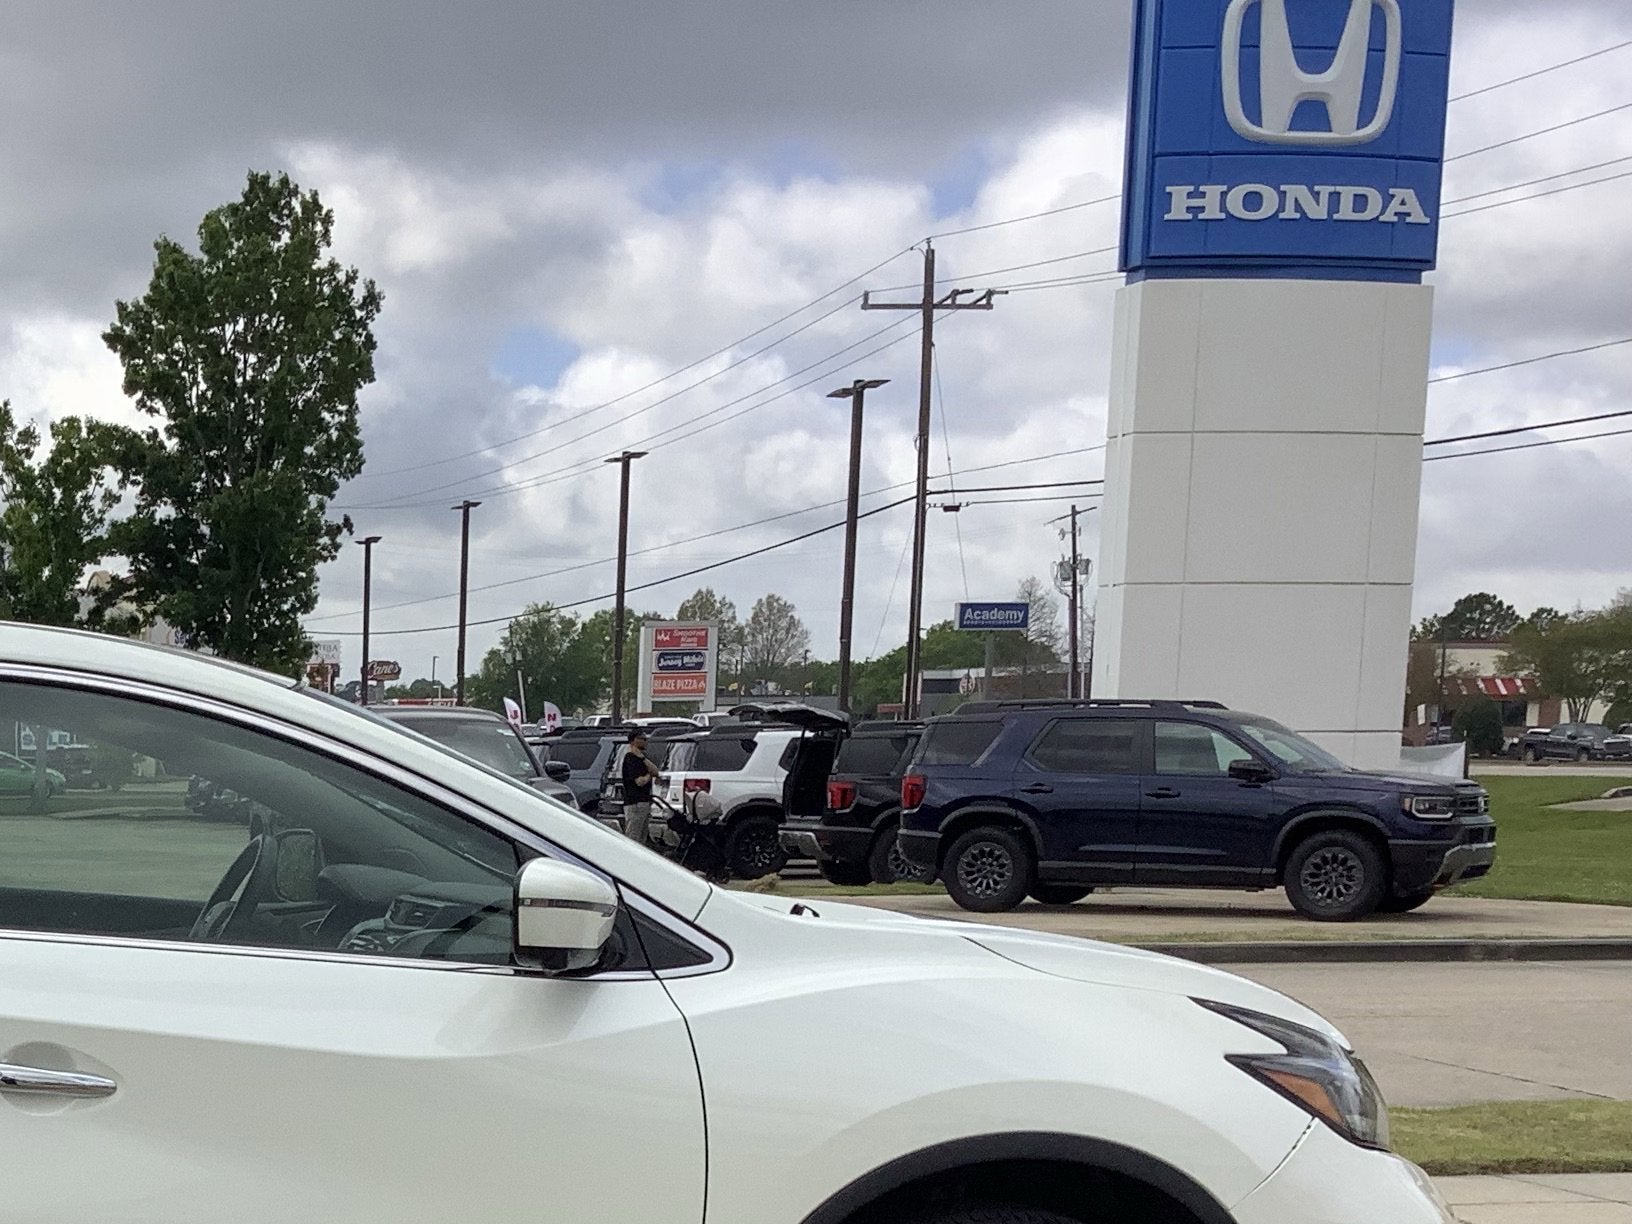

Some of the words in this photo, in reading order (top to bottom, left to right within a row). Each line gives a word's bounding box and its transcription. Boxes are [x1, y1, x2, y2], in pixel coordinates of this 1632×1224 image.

[1164, 183, 1430, 225] HONDA
[963, 607, 1025, 623] Academy
[676, 679, 698, 690] PIZZA
